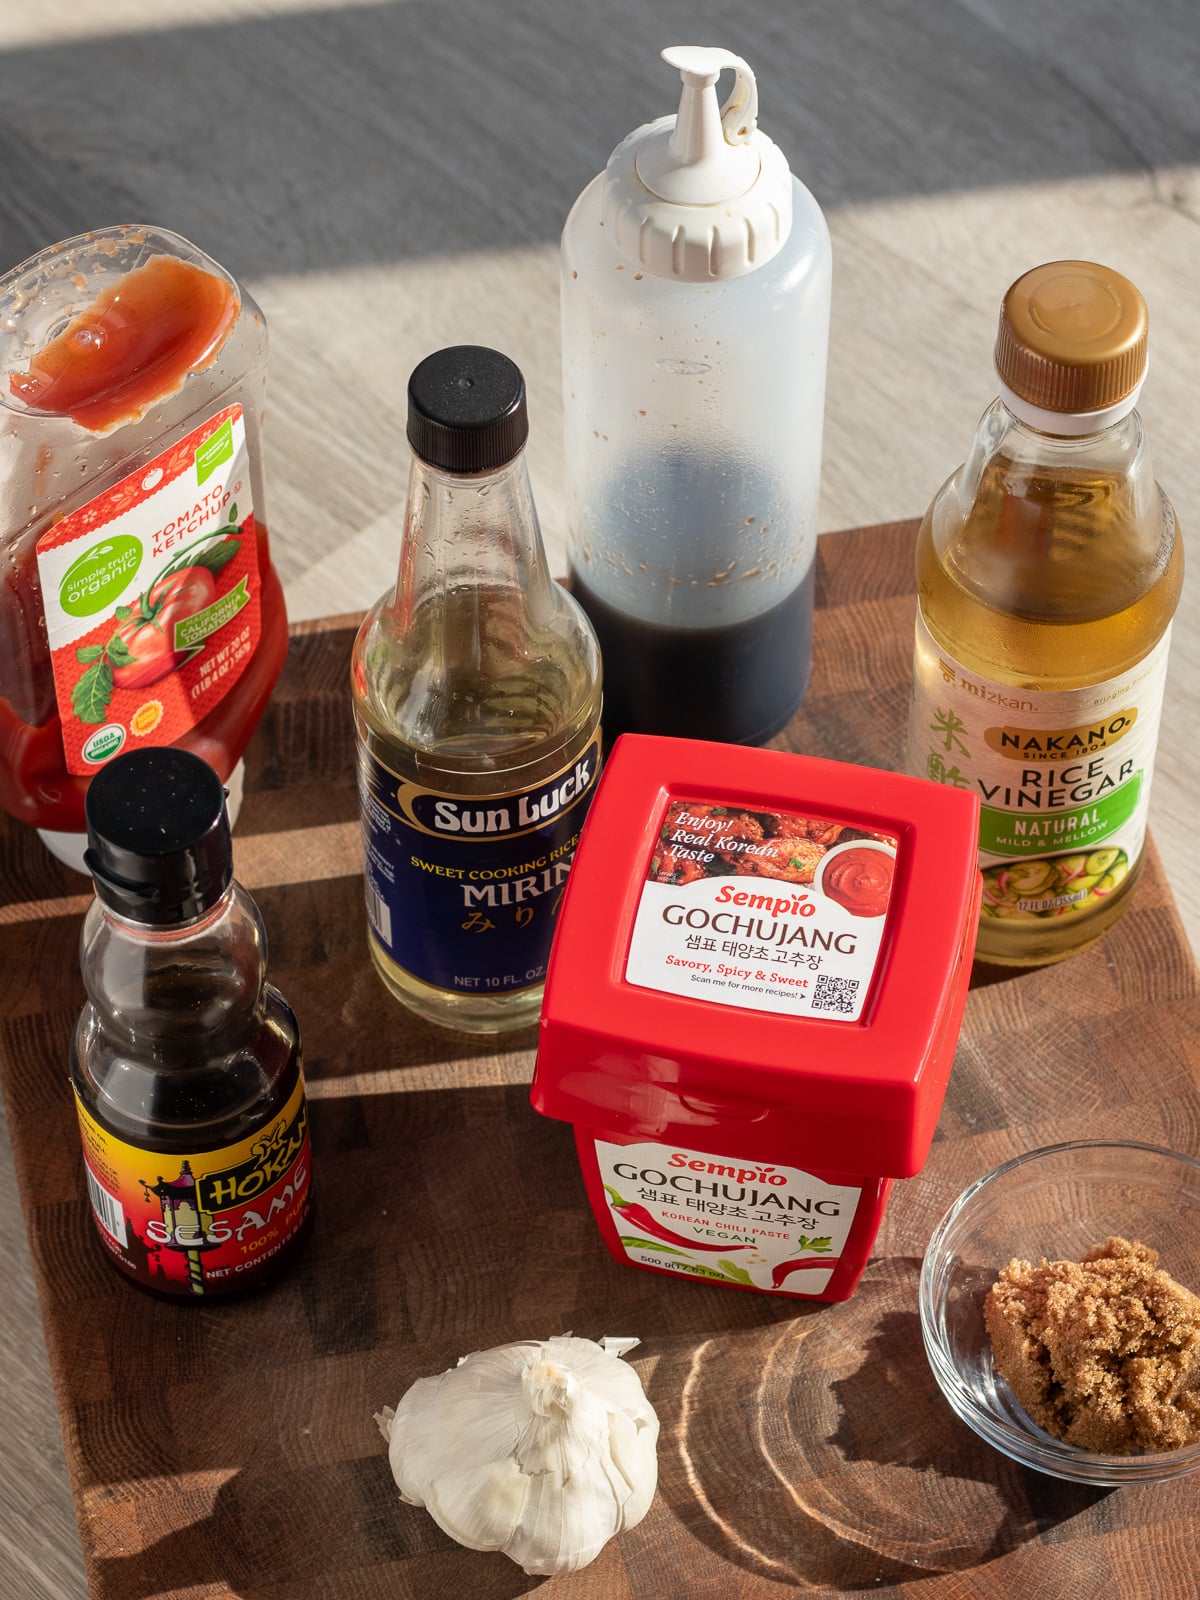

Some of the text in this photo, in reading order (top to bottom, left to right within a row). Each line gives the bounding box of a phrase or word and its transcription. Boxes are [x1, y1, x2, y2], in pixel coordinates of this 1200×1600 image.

[152, 485, 223, 543] TOMATO
[152, 491, 231, 558] KETCHUP
[67, 545, 137, 592] simple truth
[68, 556, 137, 603] organic
[180, 594, 241, 638] CALIFORNIA
[185, 605, 238, 644] TOMATOES
[199, 626, 250, 677] NET WT 20 OZ
[200, 676, 212, 692] LB
[961, 678, 1034, 712] mizkan
[93, 732, 115, 748] USDA
[1001, 717, 1126, 751] NAKANO
[1023, 741, 1107, 760] SINCE 1804
[977, 759, 1134, 808] VINEGAR
[1021, 757, 1105, 788] RICE
[434, 801, 511, 833] Sun
[518, 759, 591, 827] Luck
[674, 811, 734, 834] Enjoy!
[996, 820, 1108, 847] MILD & MELLOW
[1014, 808, 1100, 836] NATURAL
[410, 855, 465, 880] SWEET
[468, 855, 547, 880] COOKING
[550, 833, 579, 862] RICE
[669, 843, 715, 863] Taste
[670, 829, 779, 858] Real Korean
[460, 851, 576, 908] MIRIN
[714, 885, 816, 918] Sempio
[1018, 901, 1029, 911] 12
[1030, 901, 1038, 910] FL
[662, 904, 857, 955] GOCHUJANG
[684, 934, 717, 953] 샘표
[771, 949, 824, 971] 고추장
[454, 975, 481, 987] NET
[485, 977, 500, 987] 10
[503, 975, 522, 985] FL.
[665, 954, 809, 988] Savory, Spicy & Sweet
[690, 974, 798, 999] Scan me for more recipes!
[666, 1152, 788, 1187] Sempio
[146, 1155, 307, 1246] SESAME
[612, 1162, 841, 1217] GOCHUJANG
[637, 1187, 680, 1206] 샘표
[751, 1209, 820, 1231] 고추장
[661, 1210, 790, 1240] KOREAN CHILI PASTE
[240, 1228, 279, 1254] 100%
[692, 1226, 756, 1243] VEGAN
[206, 1267, 231, 1279] NET
[641, 1255, 661, 1265] 500
